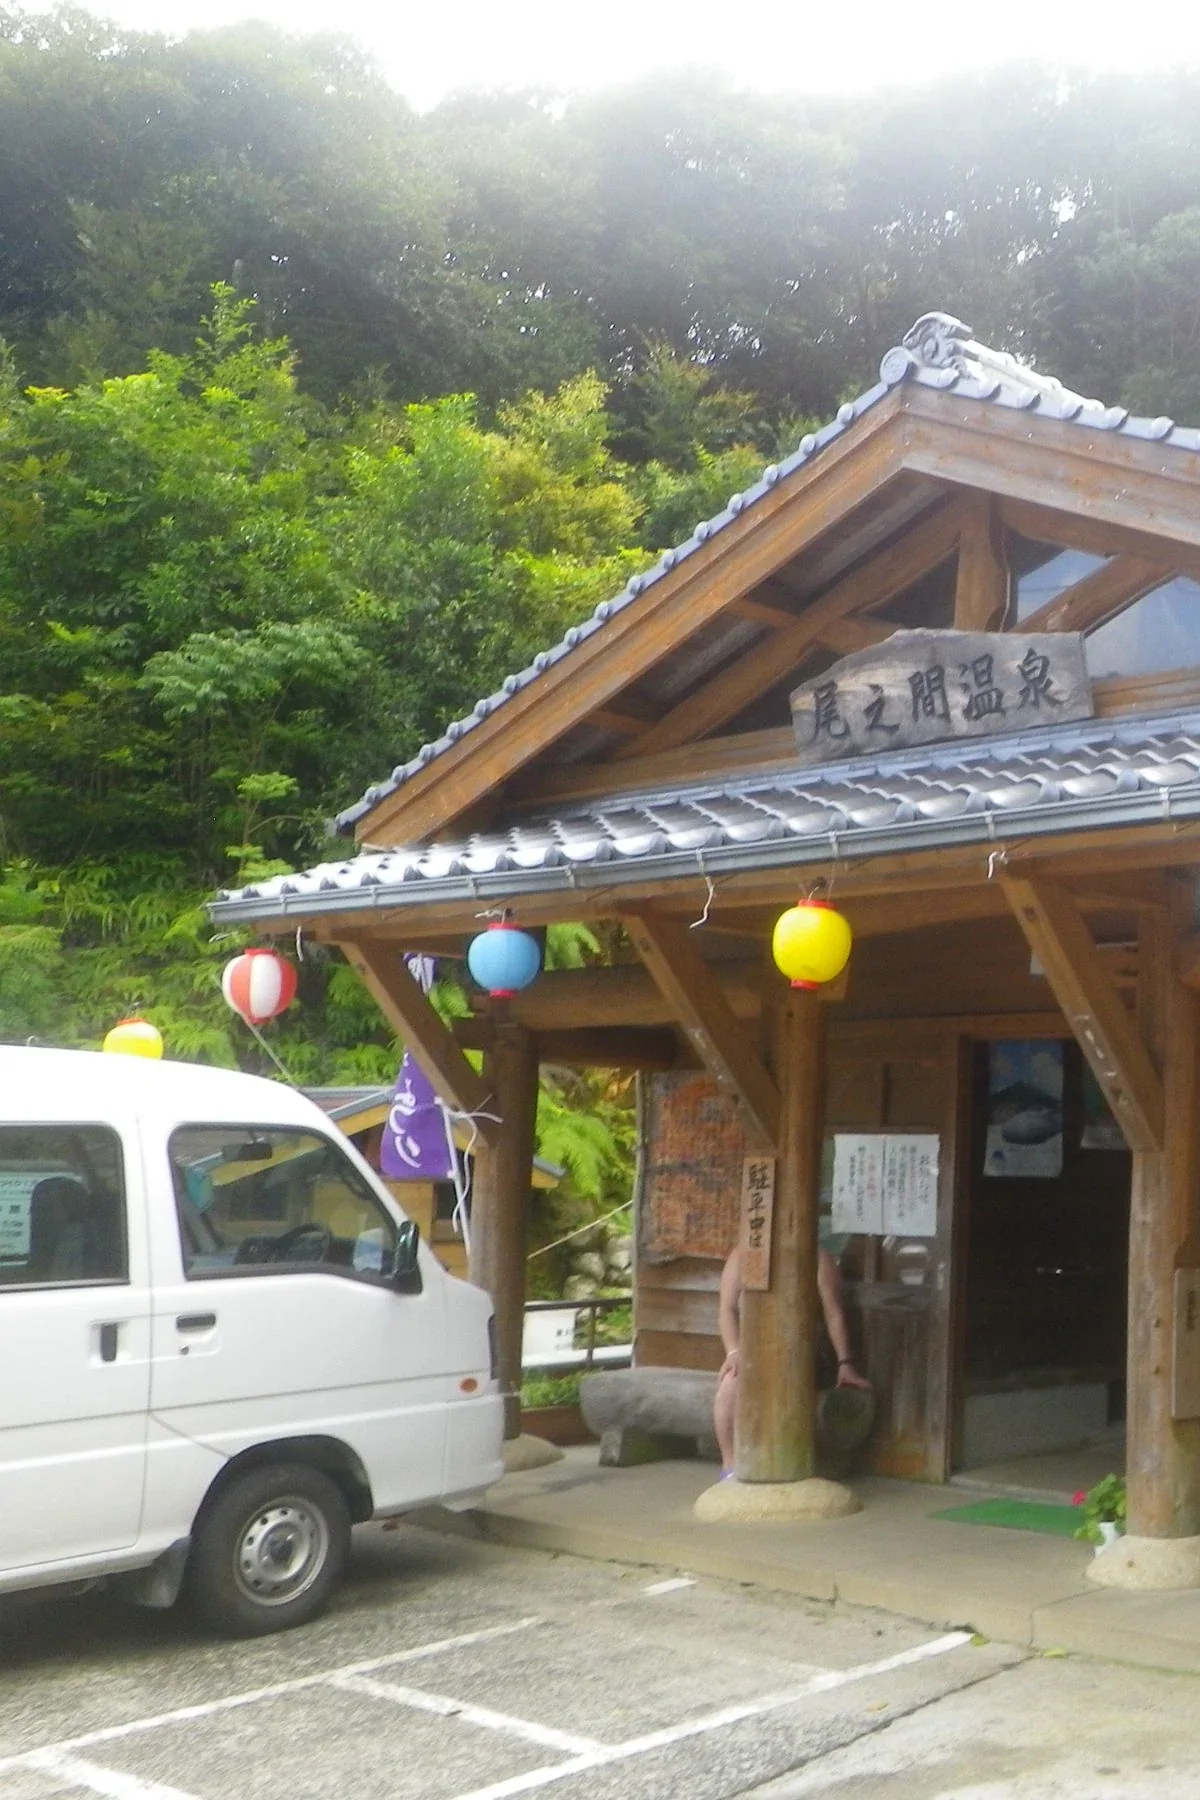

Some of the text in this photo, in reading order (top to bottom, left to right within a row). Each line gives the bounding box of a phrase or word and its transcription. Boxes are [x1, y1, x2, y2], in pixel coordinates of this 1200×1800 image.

[812, 648, 1064, 741] 尾之間温泉
